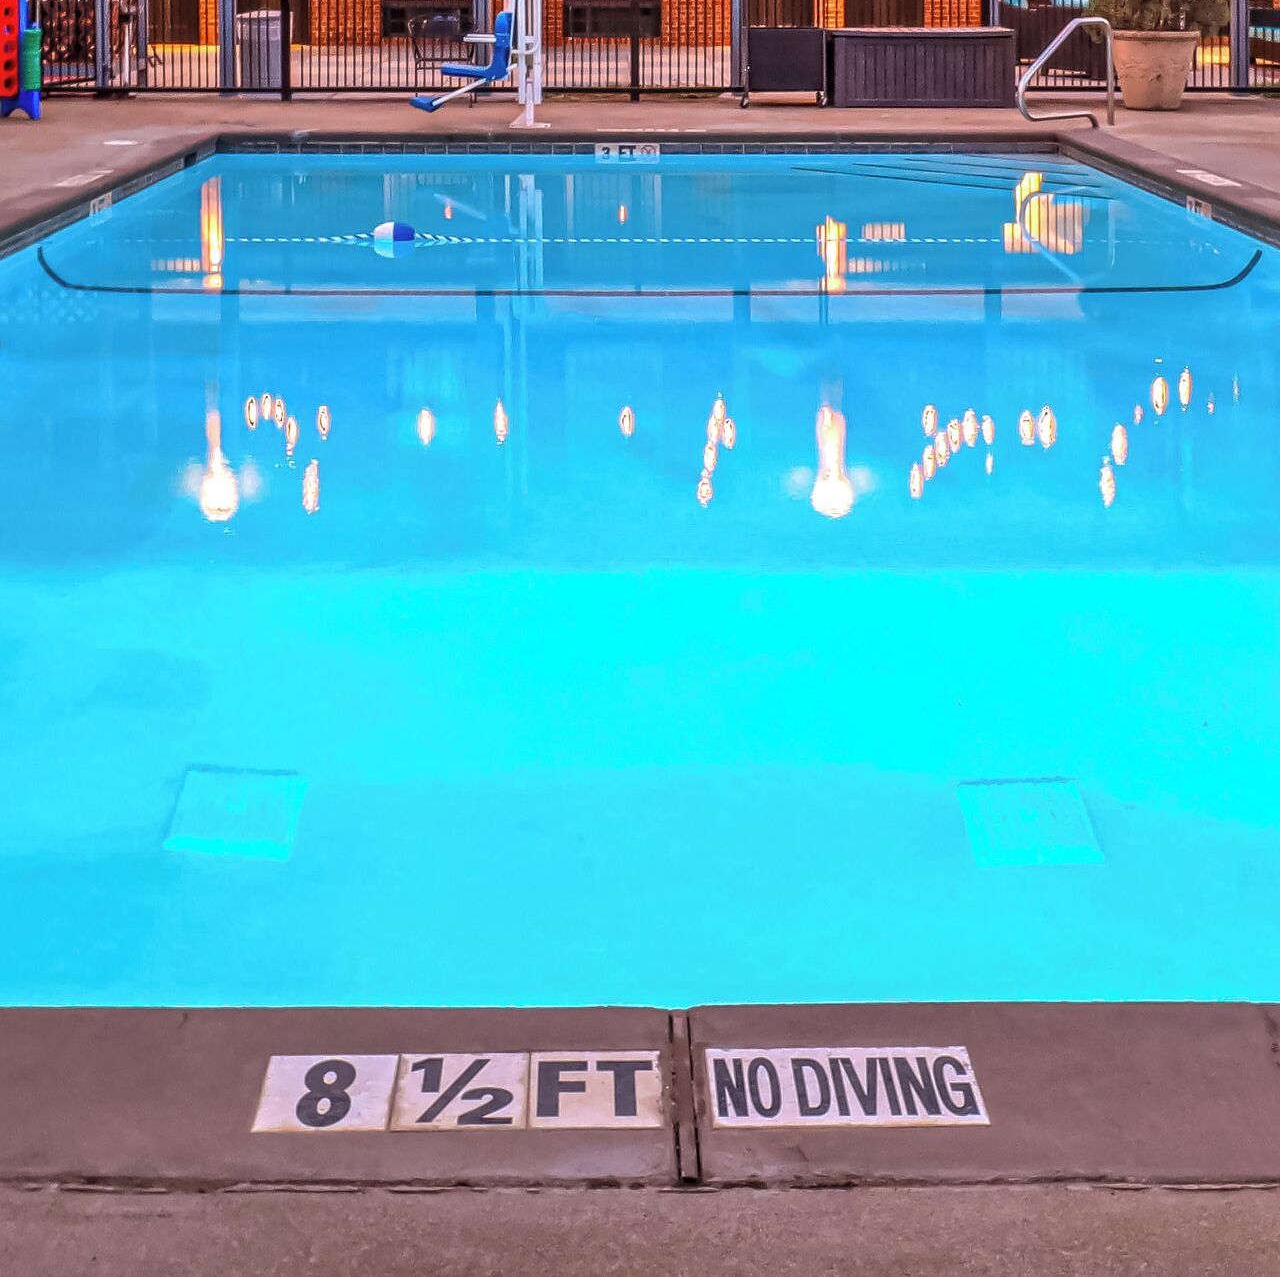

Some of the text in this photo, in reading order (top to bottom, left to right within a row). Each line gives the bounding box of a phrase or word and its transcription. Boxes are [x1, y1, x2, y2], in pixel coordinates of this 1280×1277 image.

[295, 1060, 356, 1127] 8
[537, 1060, 653, 1117] FT
[714, 1057, 980, 1118] NO DIVING
